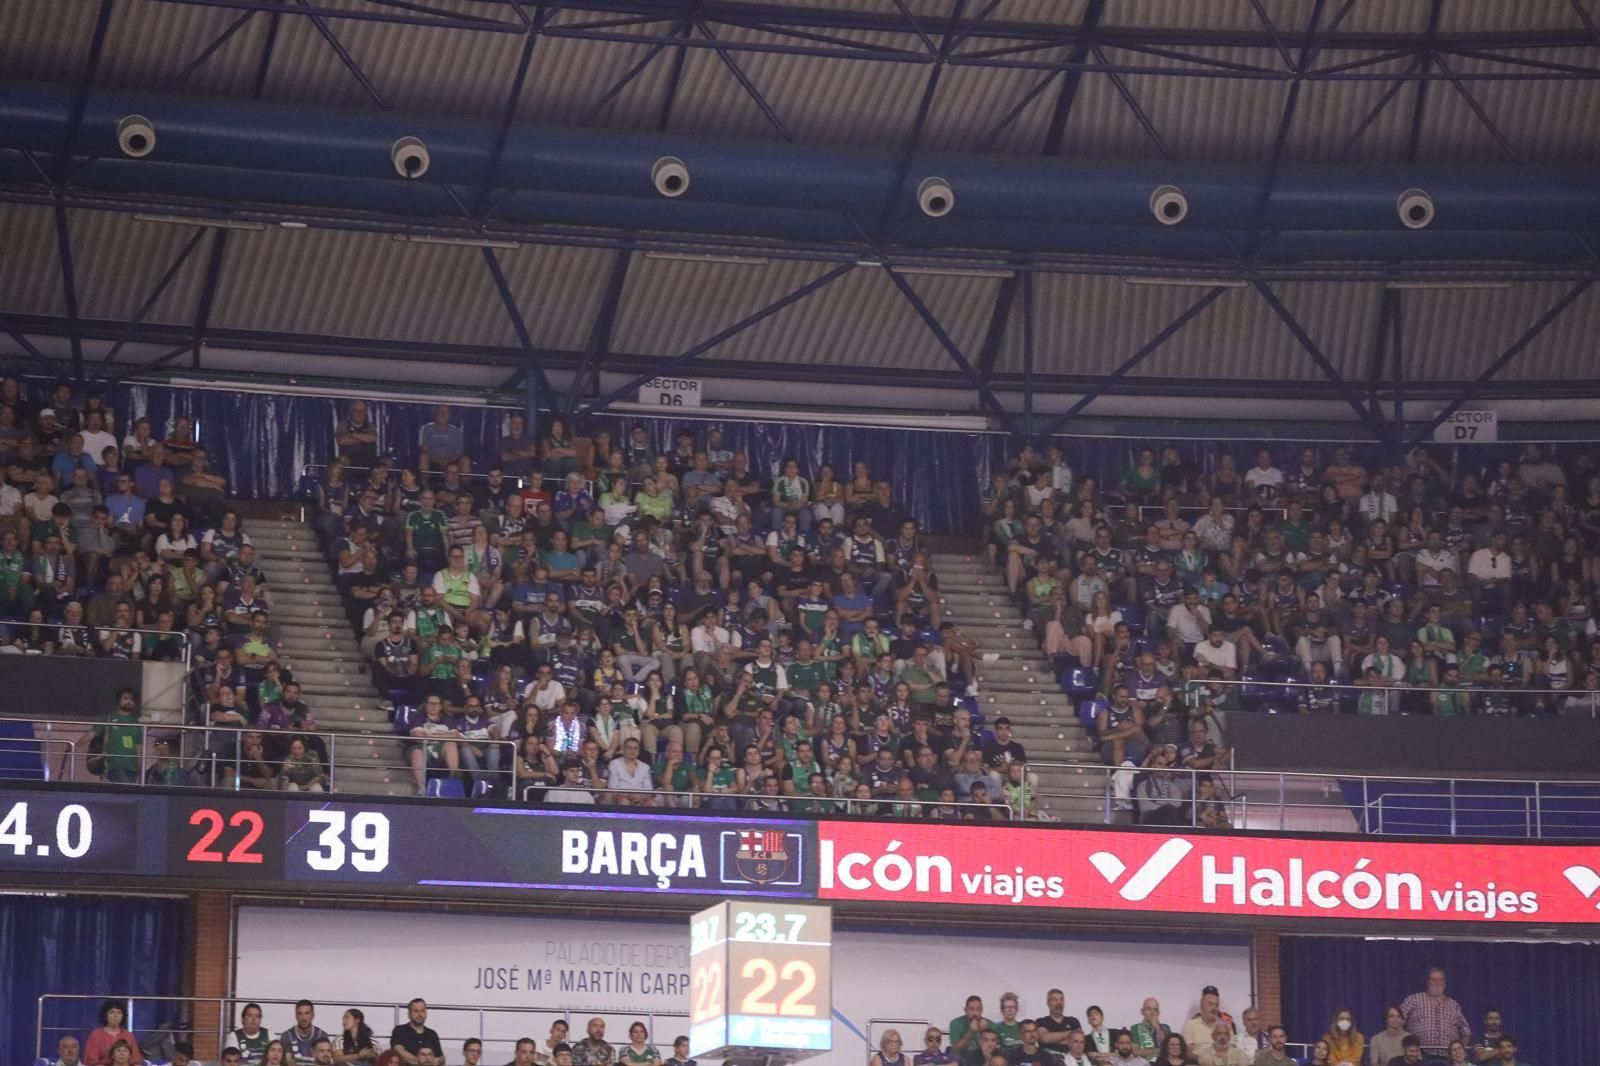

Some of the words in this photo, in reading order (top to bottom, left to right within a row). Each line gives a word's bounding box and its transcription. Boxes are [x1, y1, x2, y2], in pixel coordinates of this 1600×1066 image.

[660, 393, 682, 406] D6
[1447, 412, 1493, 423] ECTOR
[1455, 426, 1478, 440] D7
[0, 801, 93, 858] 4.0
[187, 808, 264, 863] 22
[306, 809, 390, 872] 39
[562, 829, 707, 889] BARÇA
[961, 864, 1065, 903] viajes
[1201, 855, 1422, 911] Halcón
[1430, 881, 1539, 919] viajes
[735, 911, 807, 943] 23.7
[545, 941, 616, 966] PALACIO
[620, 943, 641, 967] DE
[646, 944, 691, 969] DEPO
[474, 964, 520, 991] JOSÉ
[560, 967, 633, 994] MARTÍN
[693, 961, 721, 1024] 22
[741, 958, 816, 1016] 22
